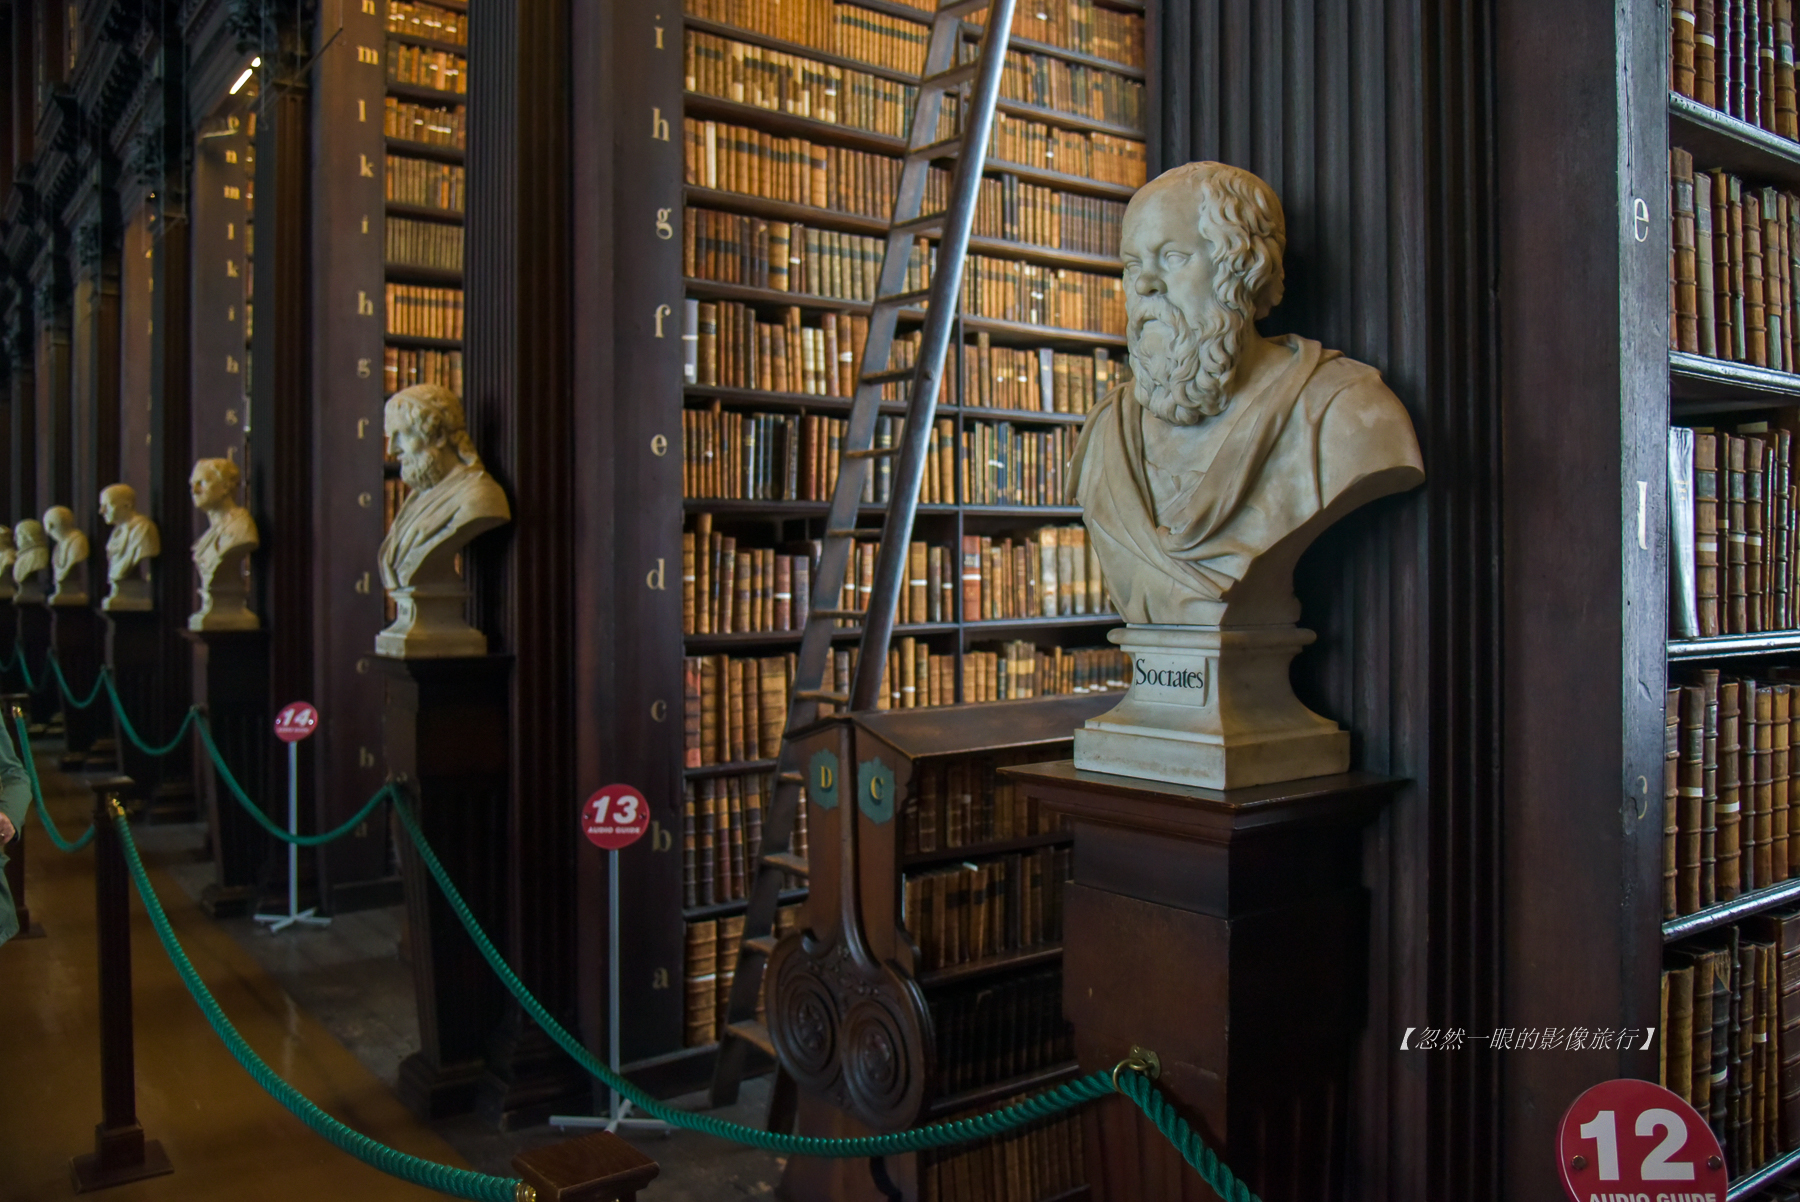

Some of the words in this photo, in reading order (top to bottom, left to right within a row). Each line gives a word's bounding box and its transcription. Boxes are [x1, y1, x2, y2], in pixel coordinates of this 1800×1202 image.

[655, 15, 664, 48] i
[357, 46, 379, 64] m
[653, 108, 670, 141] h
[360, 155, 374, 177] k
[656, 208, 673, 239] g
[1634, 198, 1649, 243] e
[358, 291, 374, 315] h
[655, 305, 672, 337] f
[358, 359, 371, 377] g
[651, 435, 668, 455] e
[358, 493, 372, 507] e
[356, 572, 370, 593] d
[647, 558, 665, 590] d
[1135, 658, 1204, 689] Socrates
[283, 708, 312, 727] 14
[651, 701, 667, 721] c
[821, 766, 833, 787] D
[870, 776, 884, 800] C
[592, 795, 639, 824] 13
[652, 821, 672, 852] b
[653, 968, 669, 989] a
[1580, 1108, 1695, 1181] 12
